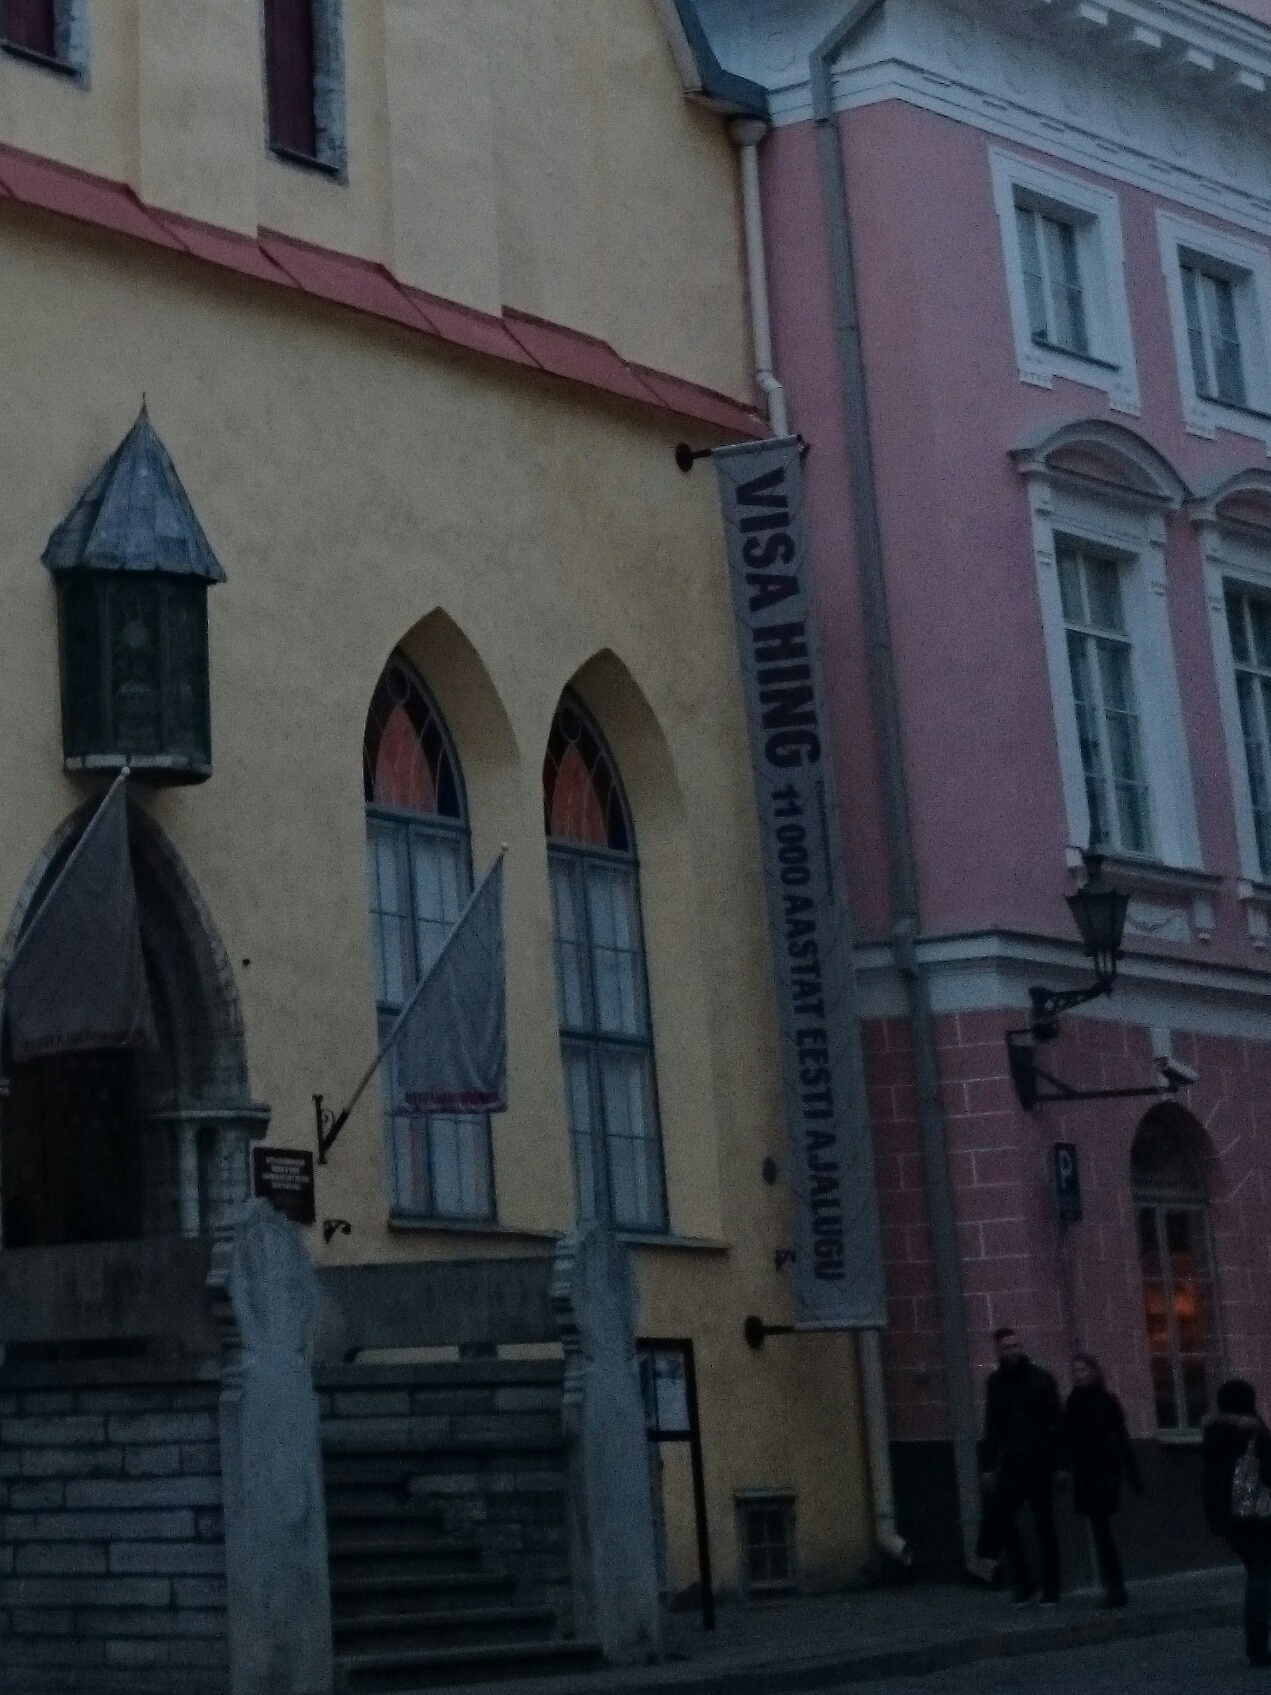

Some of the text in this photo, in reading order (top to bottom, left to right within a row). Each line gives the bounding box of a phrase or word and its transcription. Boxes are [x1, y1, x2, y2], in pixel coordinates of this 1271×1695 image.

[735, 467, 821, 769] VISA HING
[783, 894, 826, 1019] AASTAT
[796, 1028, 836, 1119] EESTI
[805, 1130, 845, 1281] AJALUGU
[1059, 1150, 1072, 1189] P
